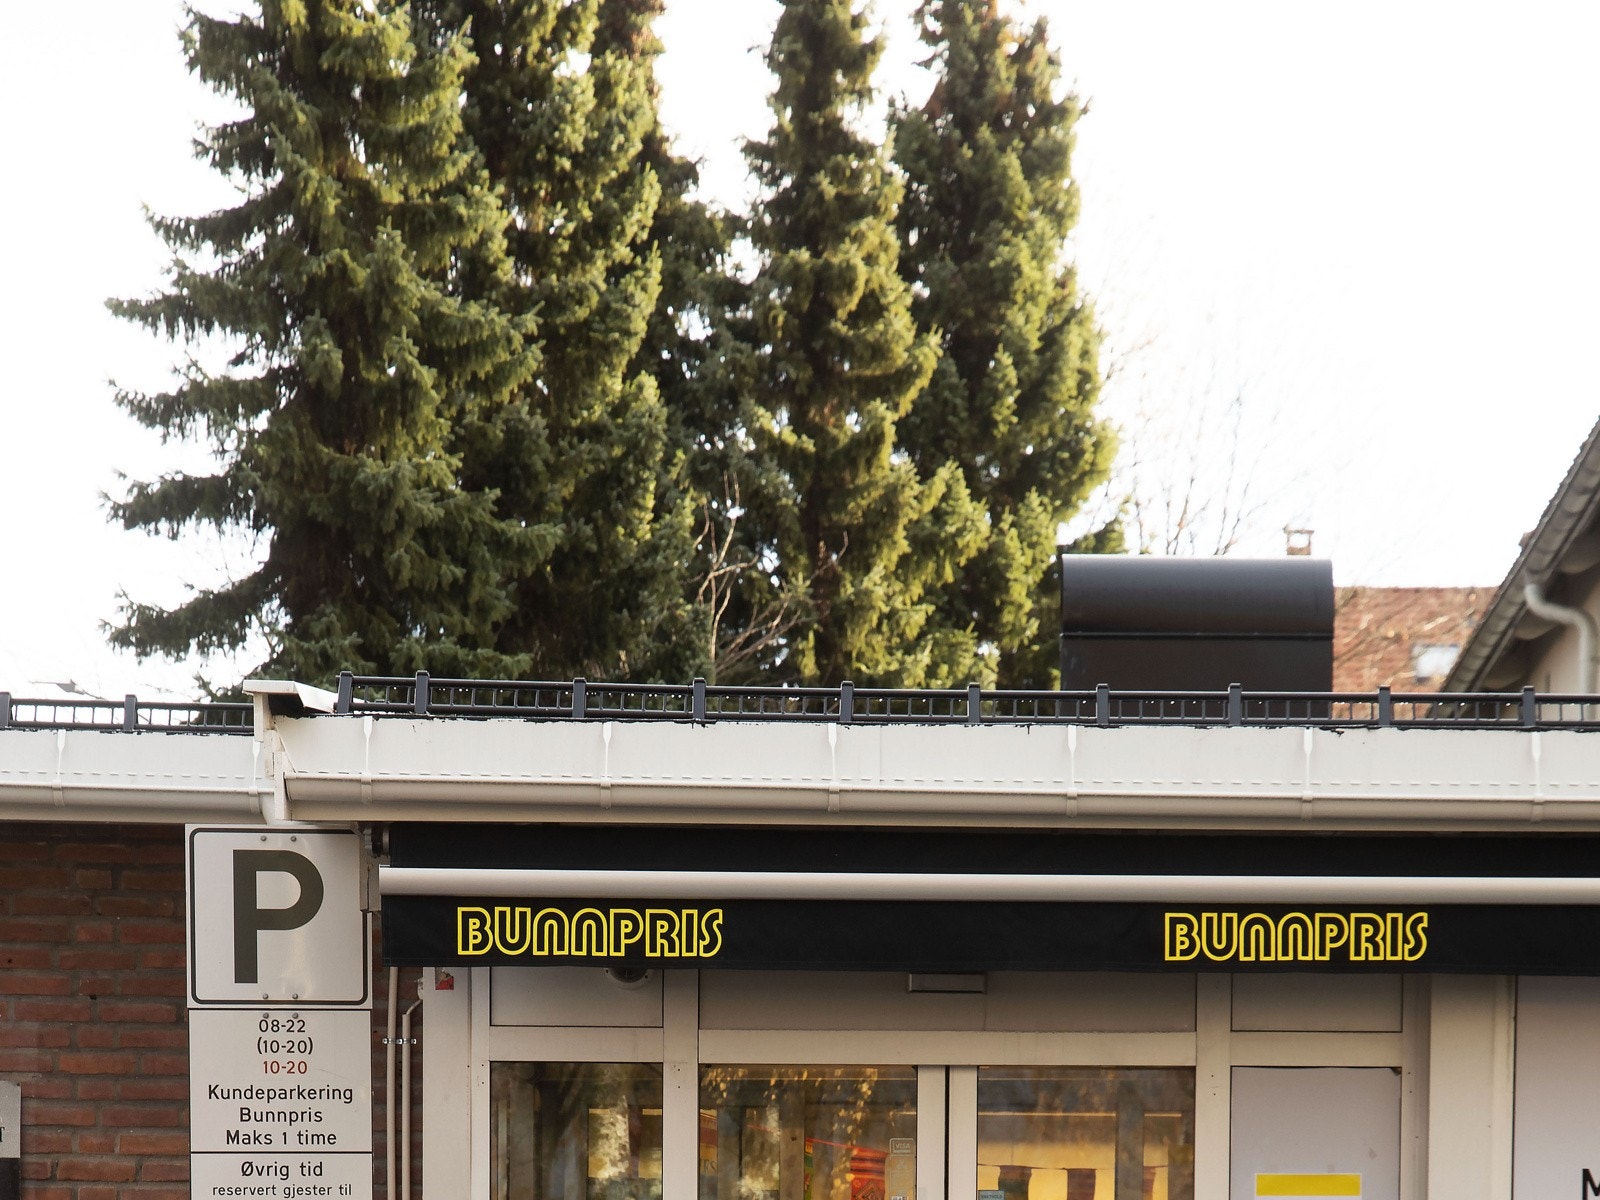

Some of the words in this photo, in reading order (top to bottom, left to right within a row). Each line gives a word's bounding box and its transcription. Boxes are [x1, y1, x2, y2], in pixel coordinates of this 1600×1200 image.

[233, 849, 324, 984] P
[457, 906, 723, 958] BUNNPRIS
[1164, 912, 1428, 961] BUNNPRIS
[259, 1019, 306, 1033] 08-22
[257, 1037, 313, 1055] (10-20)
[263, 1060, 308, 1074] 10-20
[208, 1084, 353, 1104] Kundeparkering
[239, 1107, 323, 1127] Bunnpris
[226, 1129, 273, 1145] Maks
[282, 1131, 287, 1145] 1
[297, 1129, 337, 1145] time
[241, 1161, 290, 1180] Øvrig
[300, 1161, 323, 1177] tid
[212, 1185, 277, 1196] reservert
[283, 1184, 332, 1199] gjester
[339, 1184, 352, 1196] til
